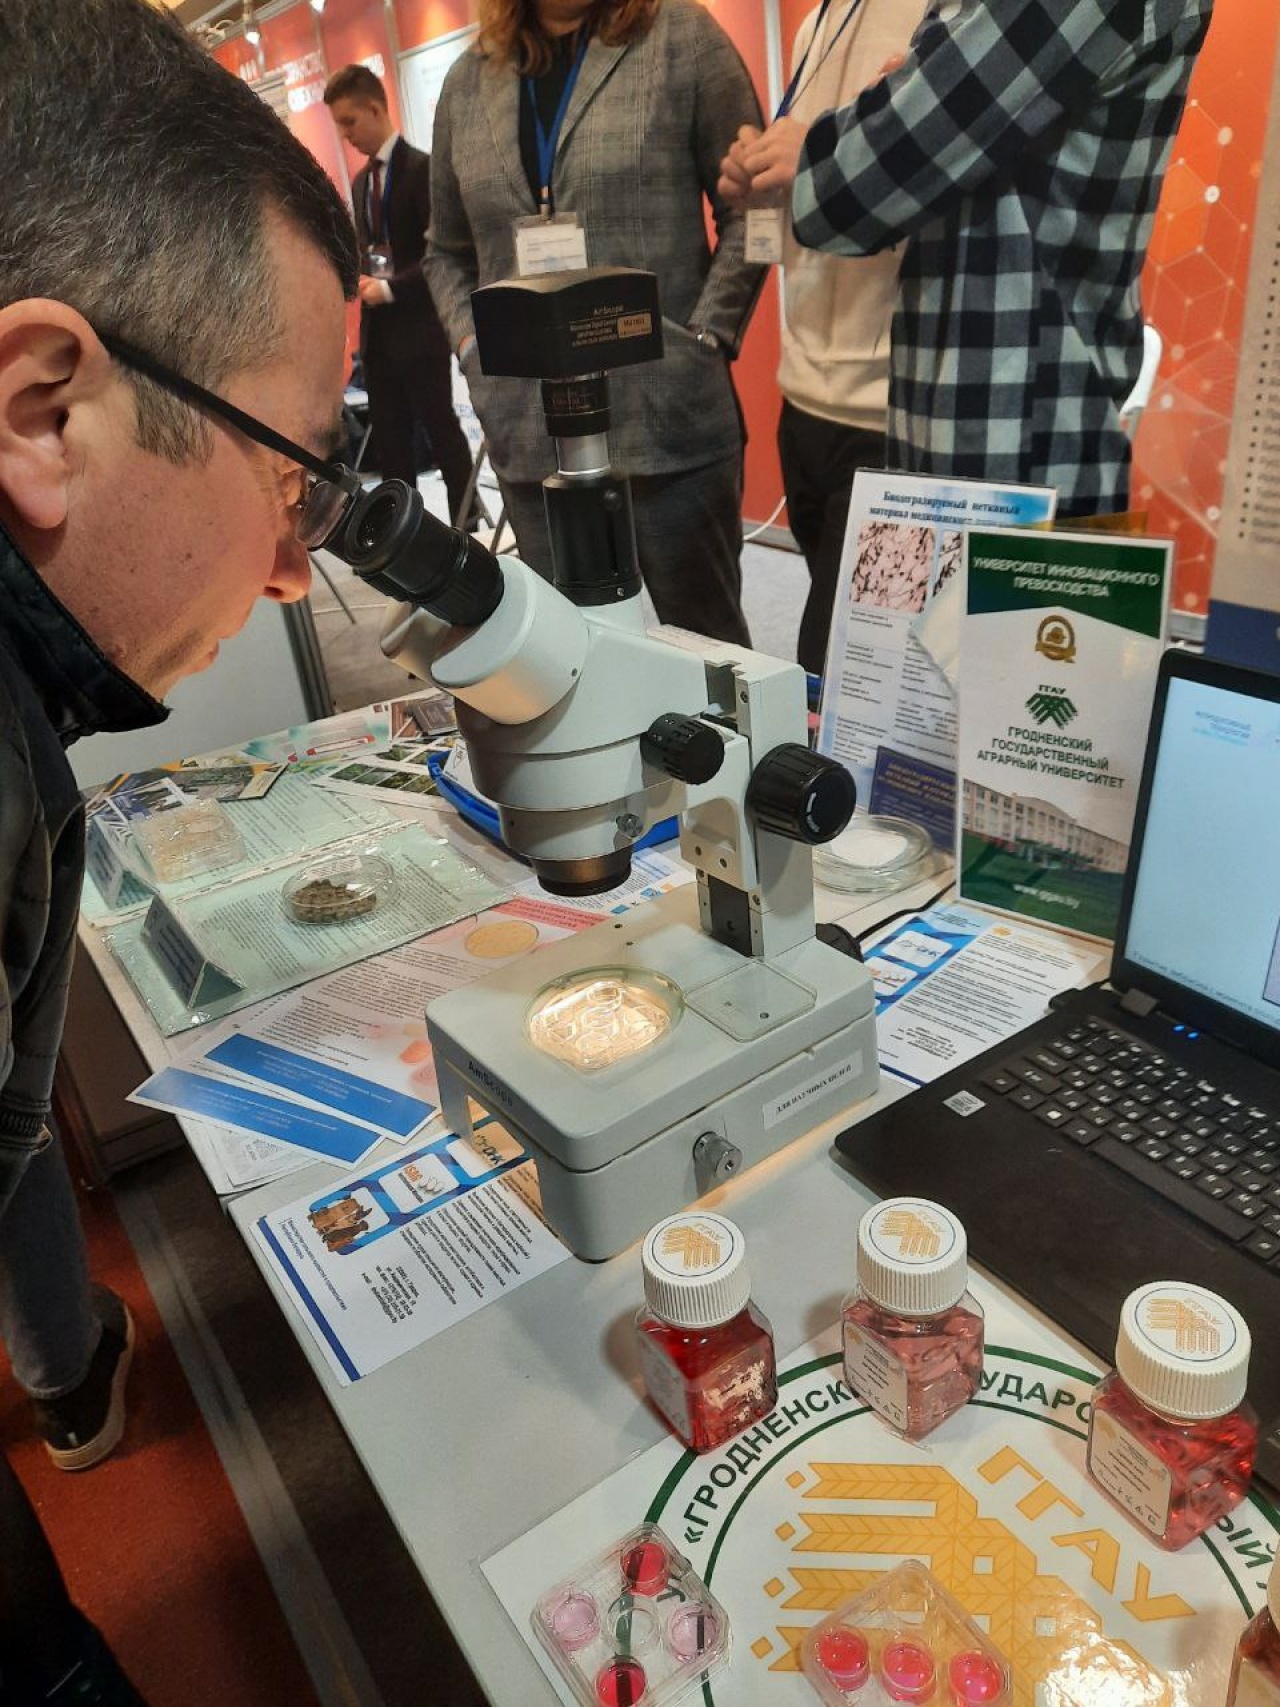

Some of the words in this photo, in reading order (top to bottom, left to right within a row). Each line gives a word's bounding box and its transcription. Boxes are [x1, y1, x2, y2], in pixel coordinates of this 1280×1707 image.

[973, 556, 1047, 574] УНИВЕРСИТЕТ
[1048, 564, 1160, 586] ИННОВАЦИОННОГО
[1013, 576, 1109, 597] ПРЕВОСХОДСТВА
[1038, 684, 1066, 695] ГГАУ
[991, 738, 1109, 770] ГОСУДАРСТВЕННЫЙ
[1008, 726, 1093, 752] ГРОДНЕНСКИЙ
[977, 750, 1038, 771] АГРАРНЫЙ
[1040, 762, 1126, 789] УНИВЕРСИТЕТ
[684, 1380, 856, 1544] «ГРОДНЕНСК
[977, 1445, 1197, 1622] ГГАУ
